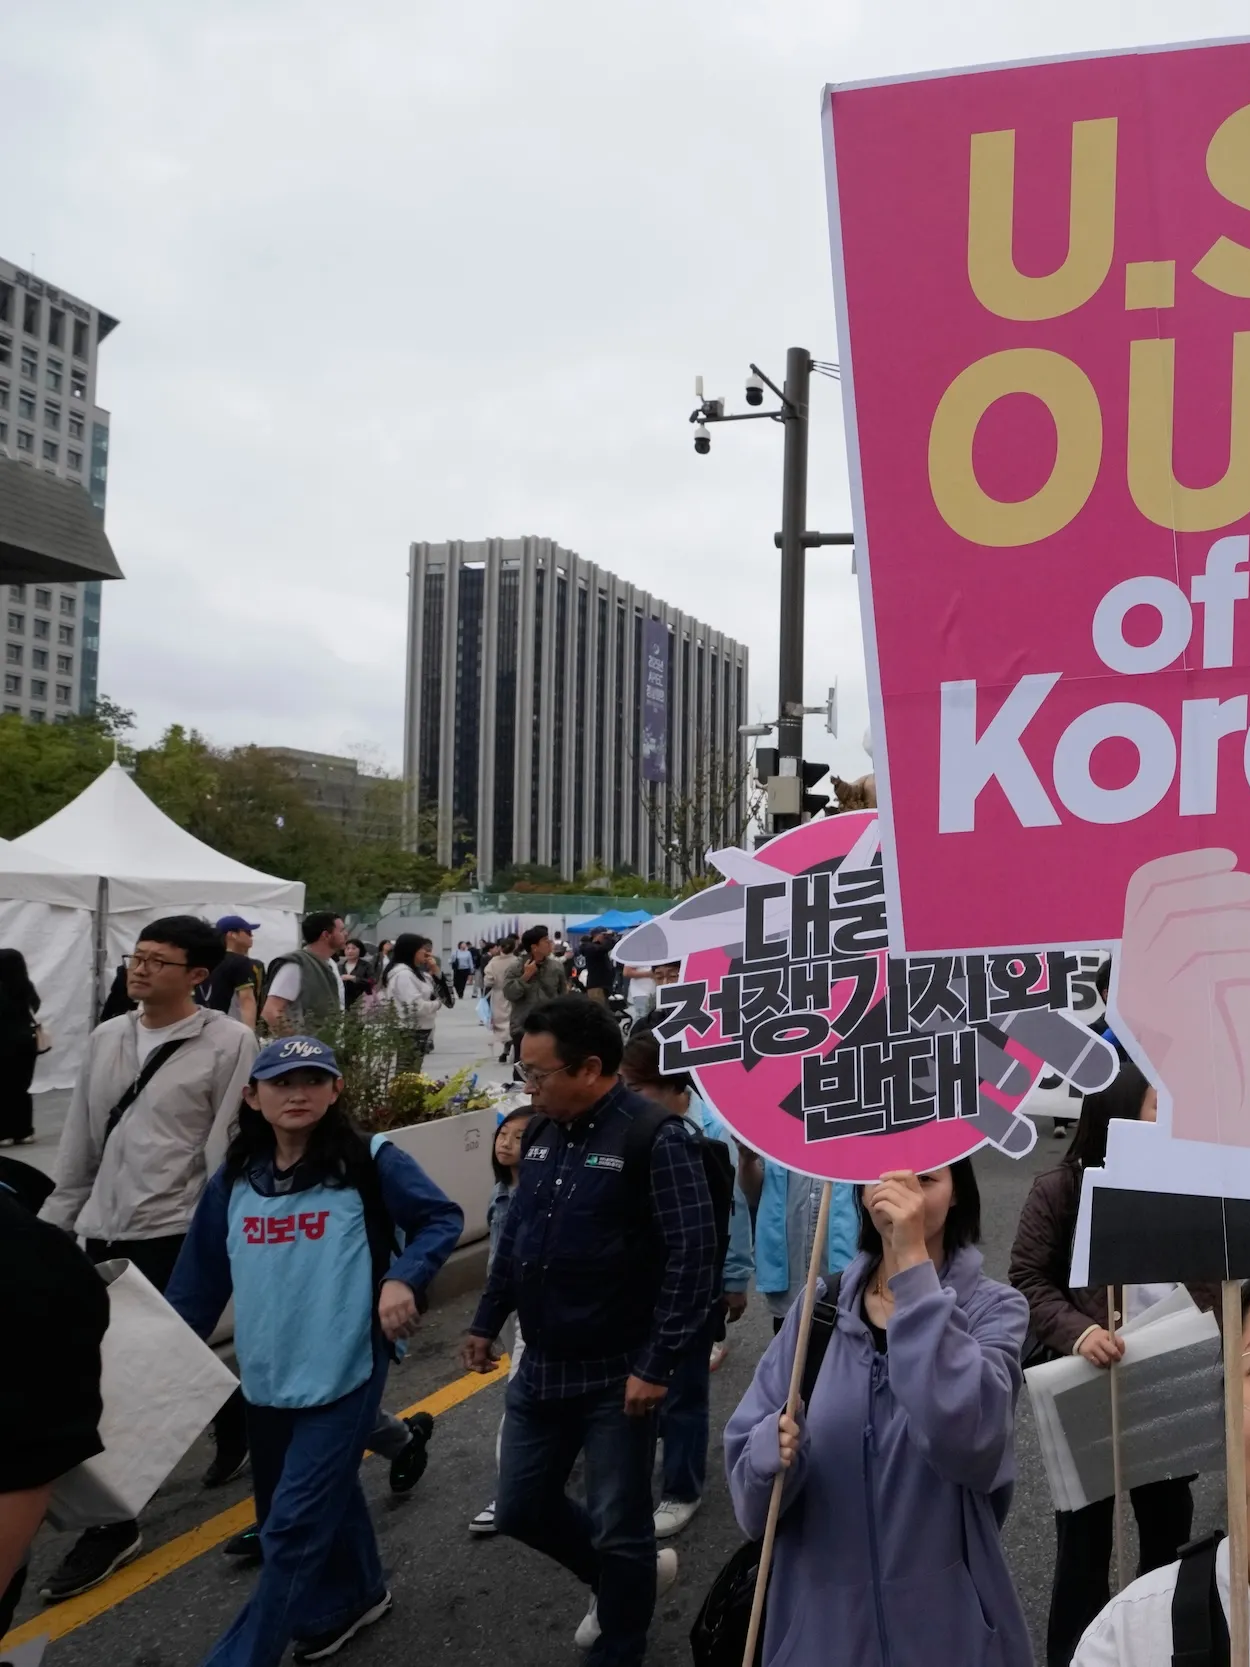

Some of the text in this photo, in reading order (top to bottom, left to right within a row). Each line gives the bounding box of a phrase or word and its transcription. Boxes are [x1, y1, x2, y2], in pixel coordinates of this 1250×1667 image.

[1092, 535, 1250, 675] of
[279, 1041, 323, 1058] Nyc
[802, 1029, 979, 1144] 반대
[242, 1210, 330, 1245] 진보당
